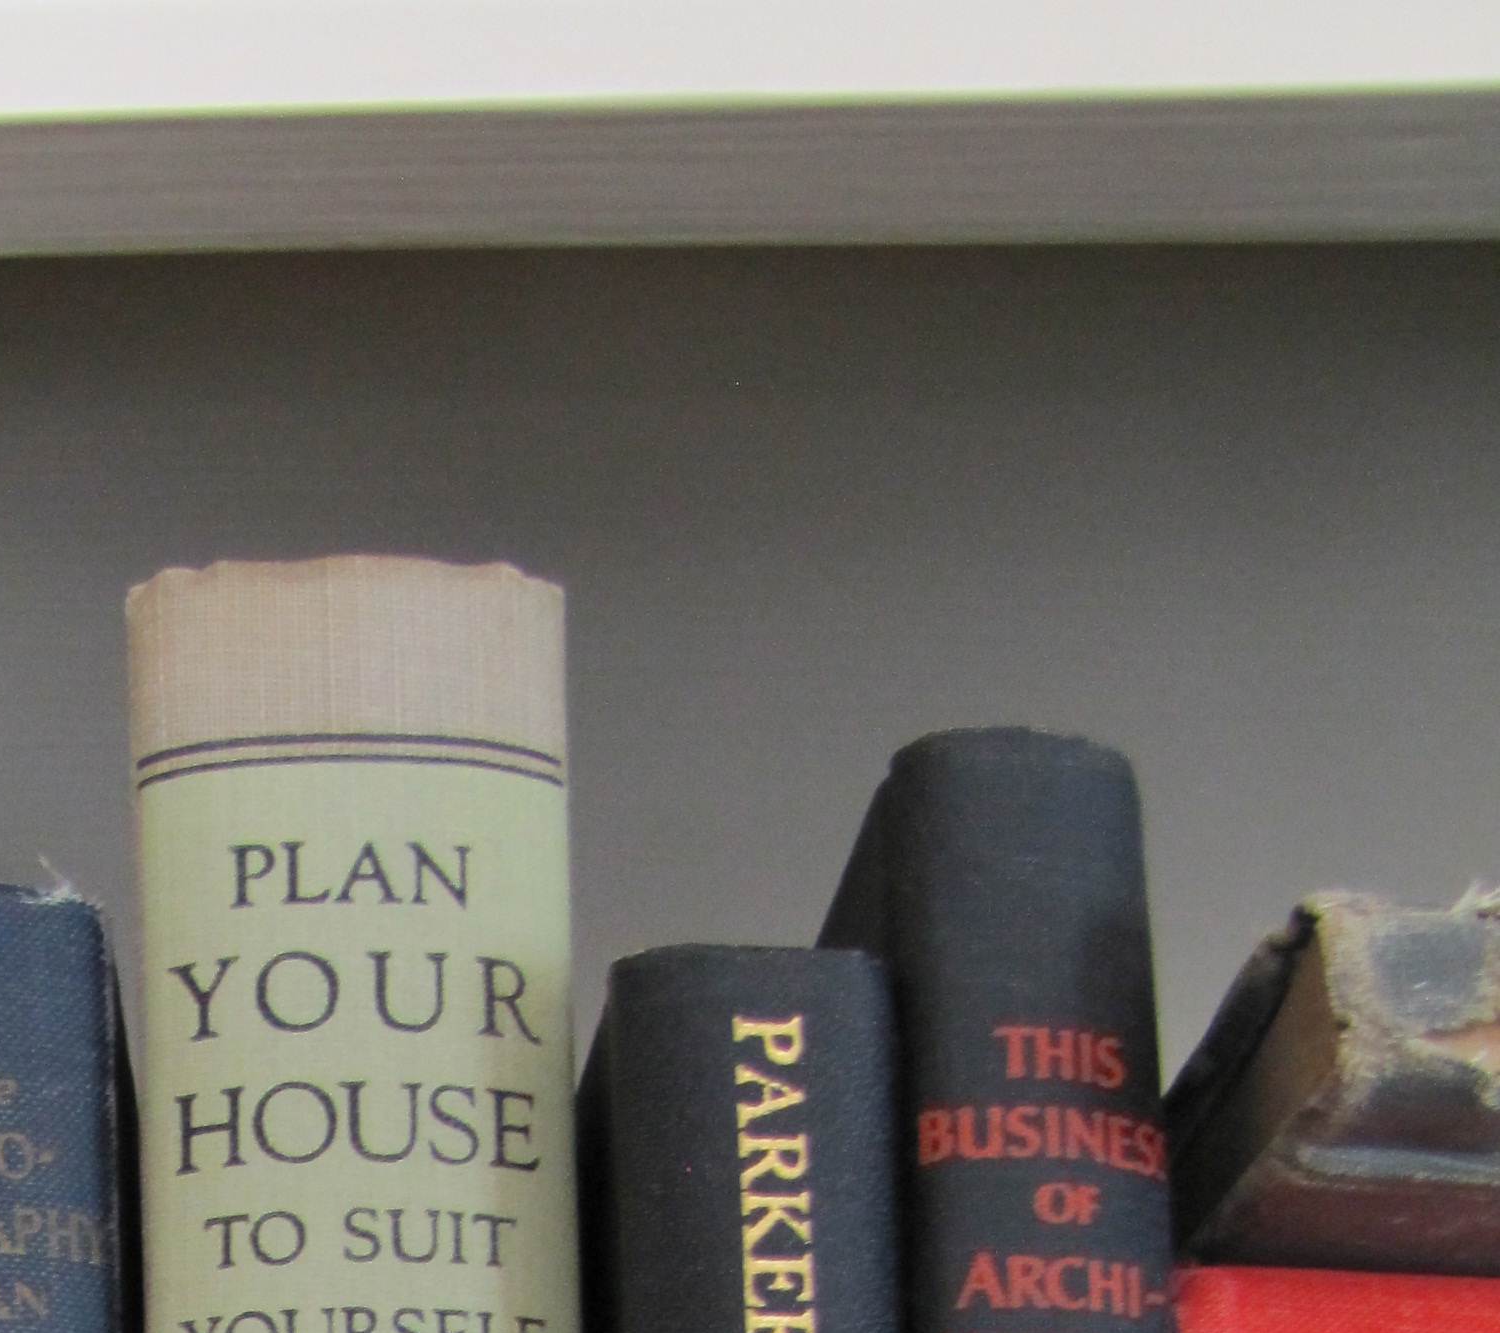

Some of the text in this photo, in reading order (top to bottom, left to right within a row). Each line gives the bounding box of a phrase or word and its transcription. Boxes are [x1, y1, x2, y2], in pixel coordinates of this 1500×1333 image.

[228, 841, 470, 910] PLAN
[168, 951, 541, 1045] YOUR
[992, 1025, 1127, 1090] THIS
[174, 1081, 540, 1176] HOUSE
[916, 1105, 1167, 1182] BUSINES
[1033, 1181, 1103, 1225] OF
[204, 1207, 517, 1269] TO SUIT
[955, 1251, 1167, 1318] ARCHI-
